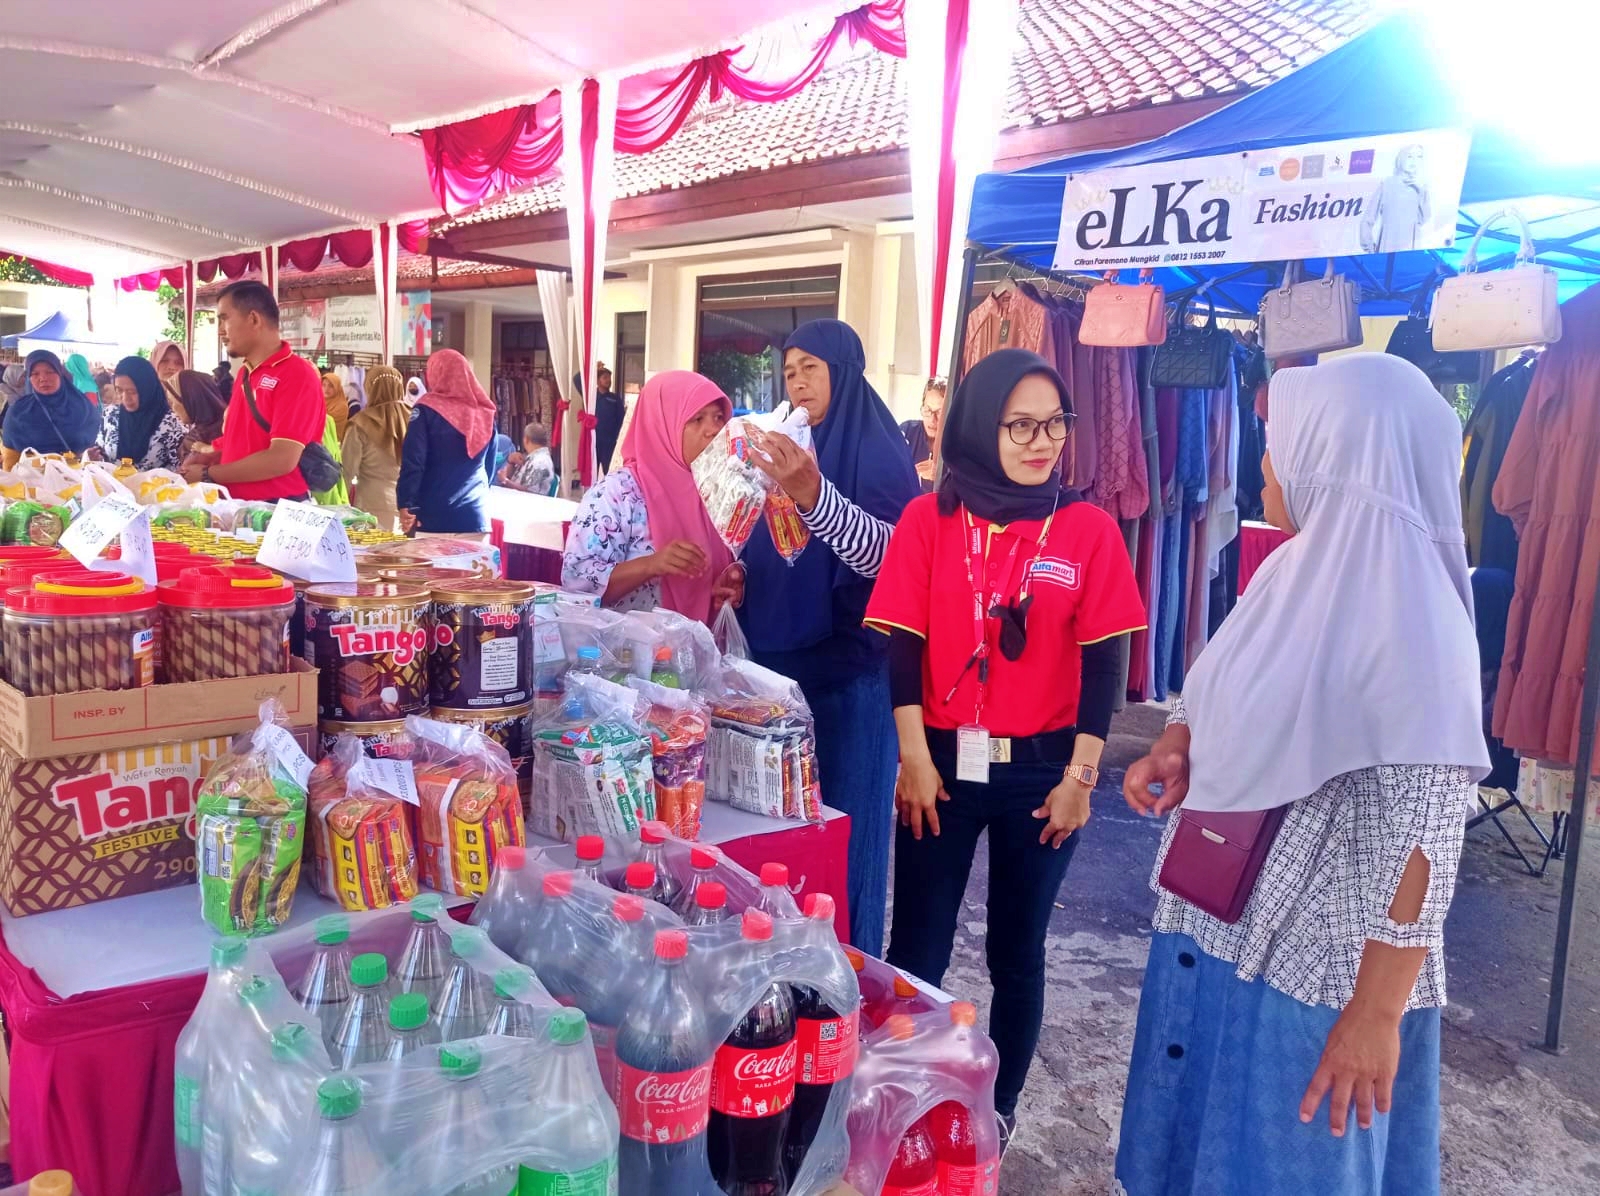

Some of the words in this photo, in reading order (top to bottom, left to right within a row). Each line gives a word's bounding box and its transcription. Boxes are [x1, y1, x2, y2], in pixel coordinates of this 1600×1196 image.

[1076, 179, 1232, 250] eLKa
[1253, 193, 1363, 224] Fashion
[480, 613, 520, 629] Tango
[331, 624, 426, 666] Tango
[73, 708, 105, 719] INSP.
[108, 707, 126, 716] BY
[56, 772, 204, 839] Tan
[101, 828, 173, 855] FESTIVE
[154, 856, 196, 880] 290
